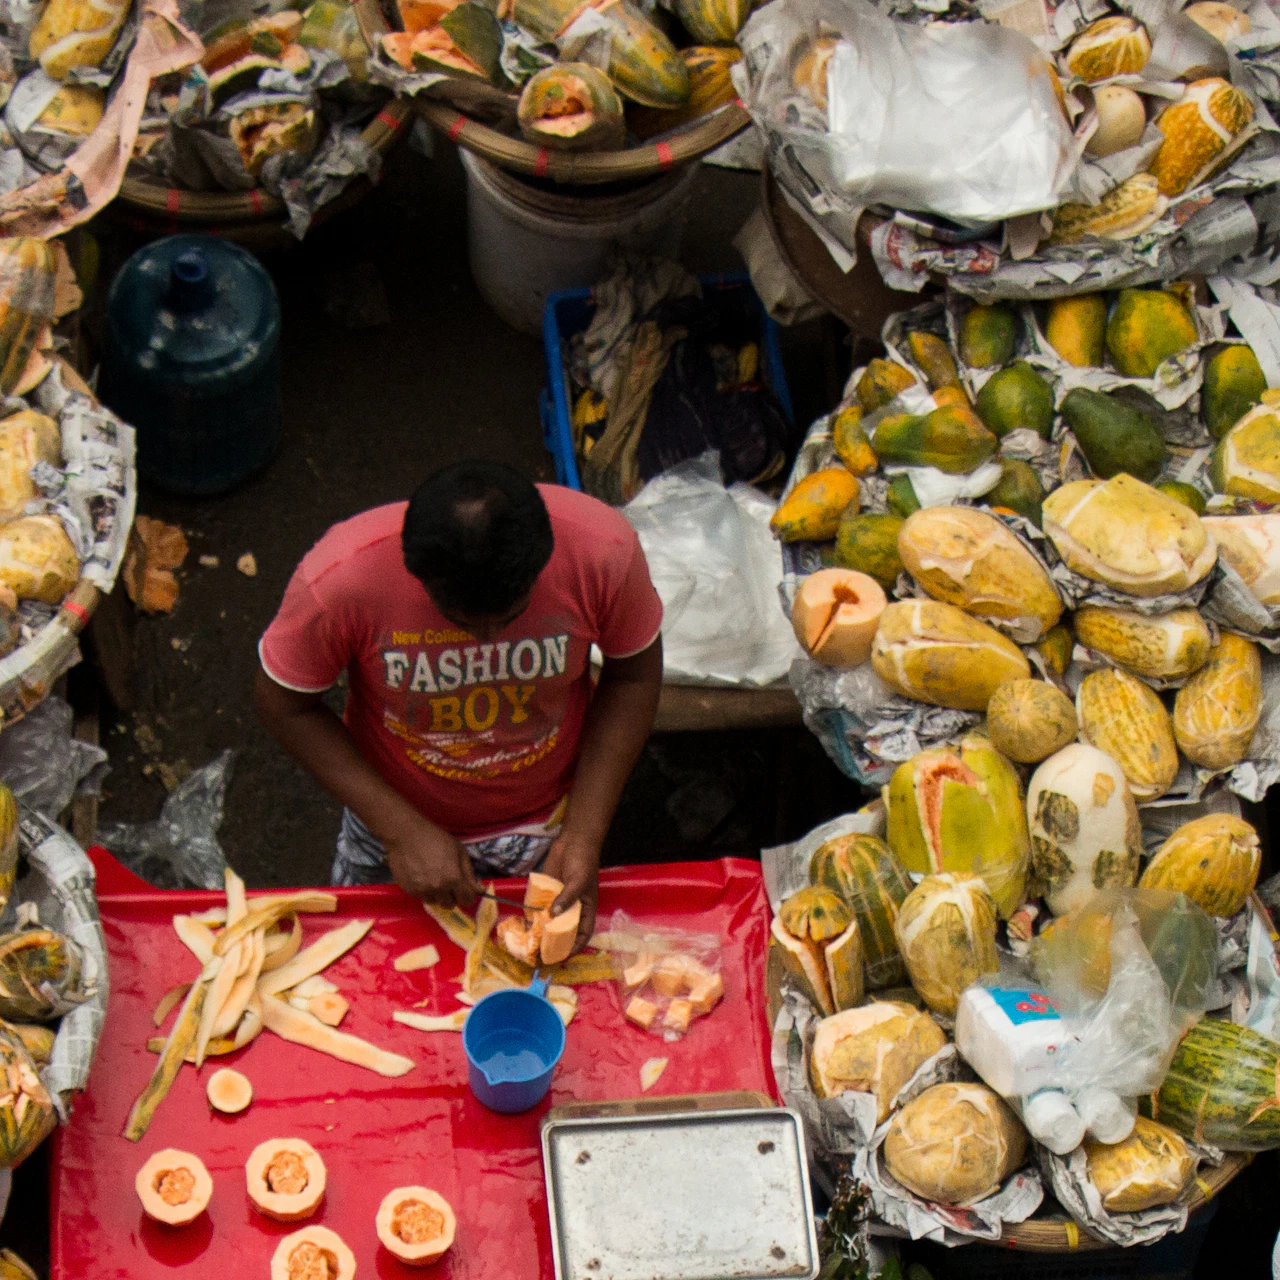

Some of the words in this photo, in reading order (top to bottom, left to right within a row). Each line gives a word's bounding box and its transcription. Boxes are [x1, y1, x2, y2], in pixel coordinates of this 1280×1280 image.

[391, 630, 421, 645] New
[383, 633, 570, 693] FASHION
[427, 684, 537, 733] BOY
